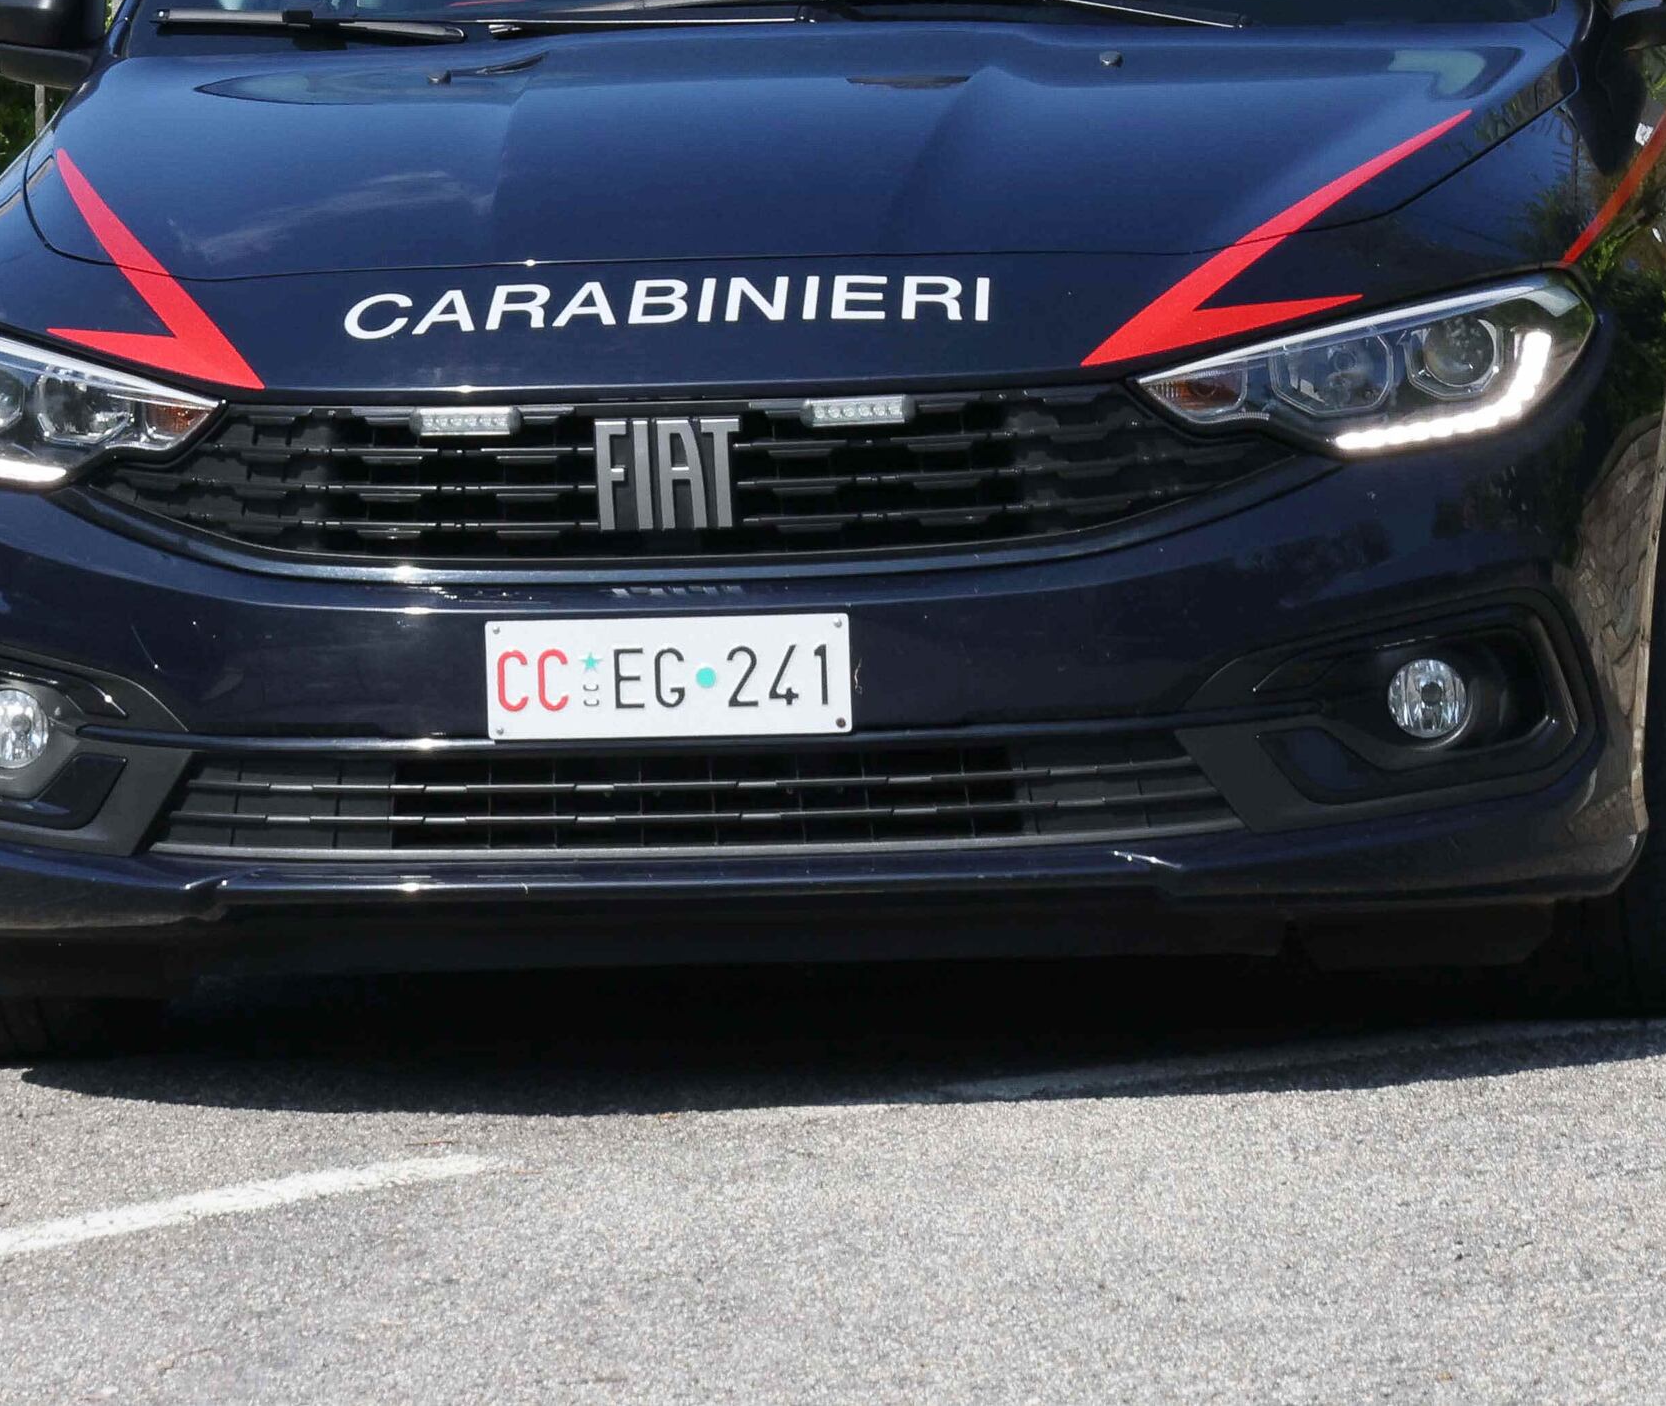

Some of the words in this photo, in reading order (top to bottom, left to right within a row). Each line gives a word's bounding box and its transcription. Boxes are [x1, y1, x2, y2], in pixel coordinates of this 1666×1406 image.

[343, 275, 991, 341] CARABINIERI
[593, 416, 740, 532] FIAT
[496, 649, 569, 712] CC
[613, 647, 686, 709] EG
[726, 644, 829, 707] 241
